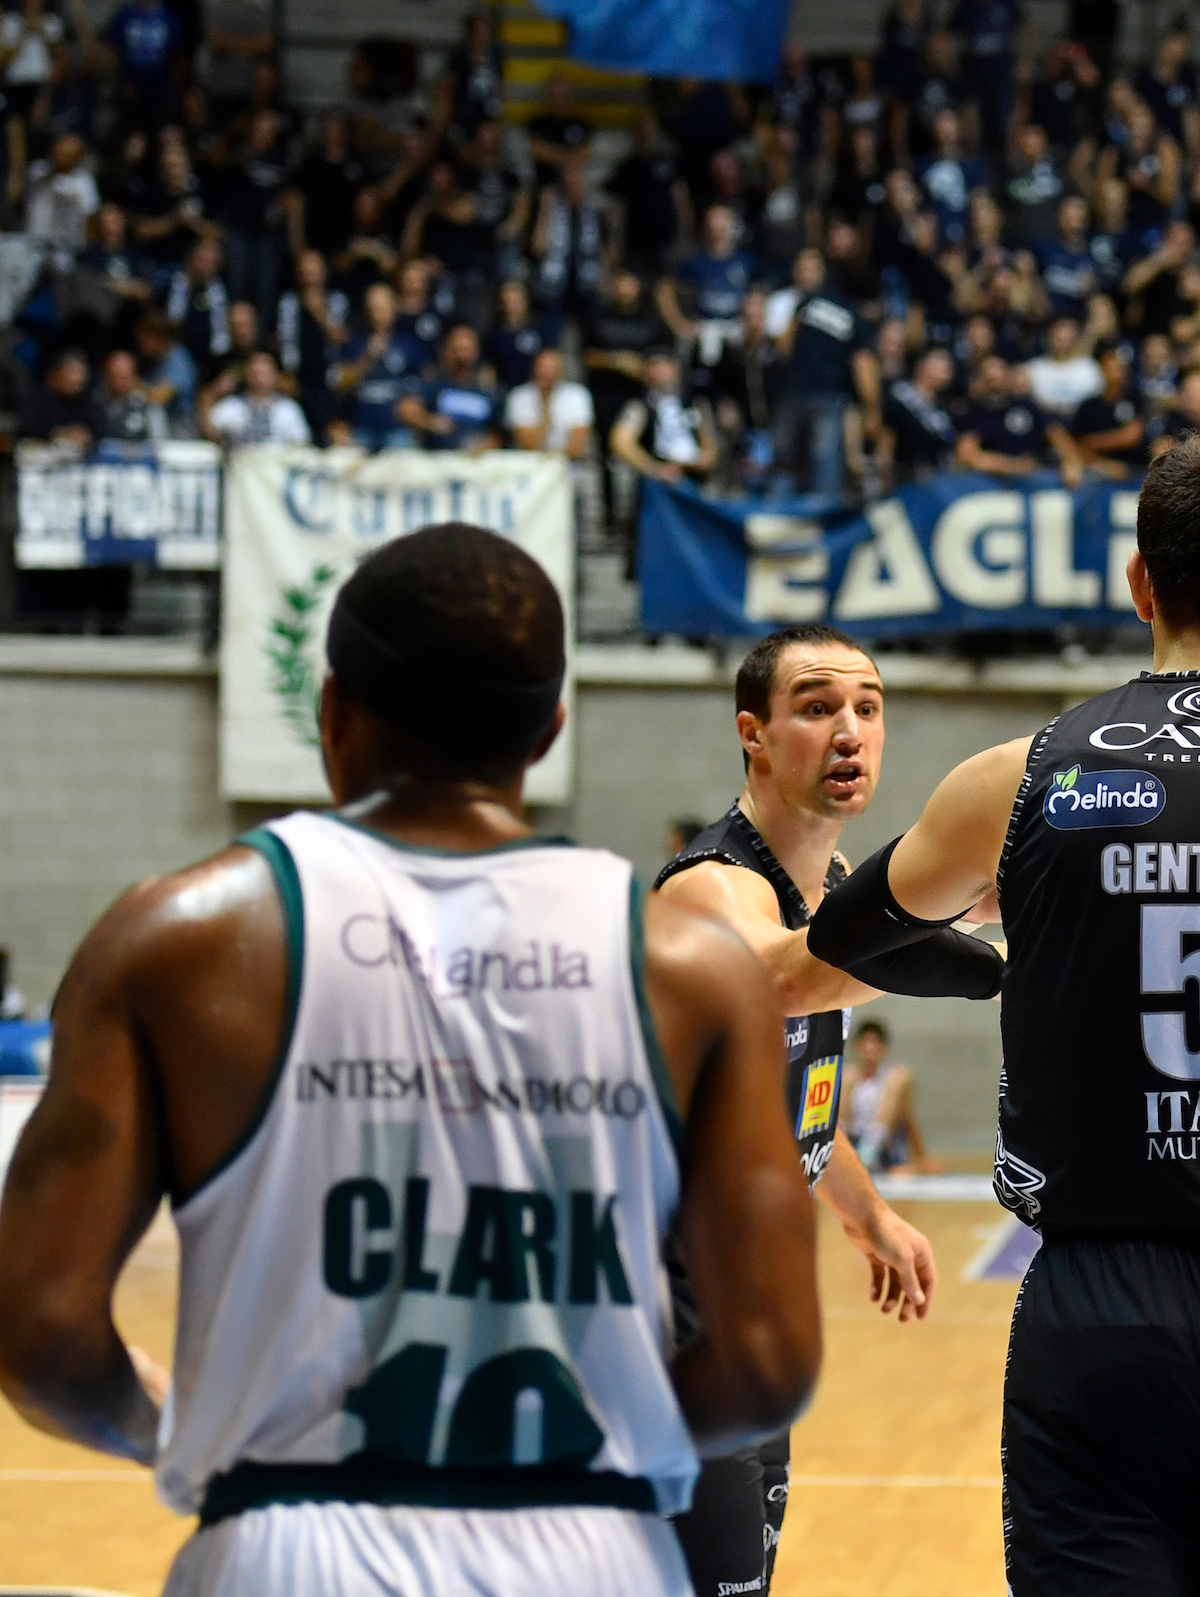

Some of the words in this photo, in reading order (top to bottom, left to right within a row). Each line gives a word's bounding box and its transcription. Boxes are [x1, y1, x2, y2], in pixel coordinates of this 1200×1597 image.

[784, 1023, 808, 1048] inda
[323, 1176, 634, 1305] CLARK
[342, 1339, 604, 1468] 10
